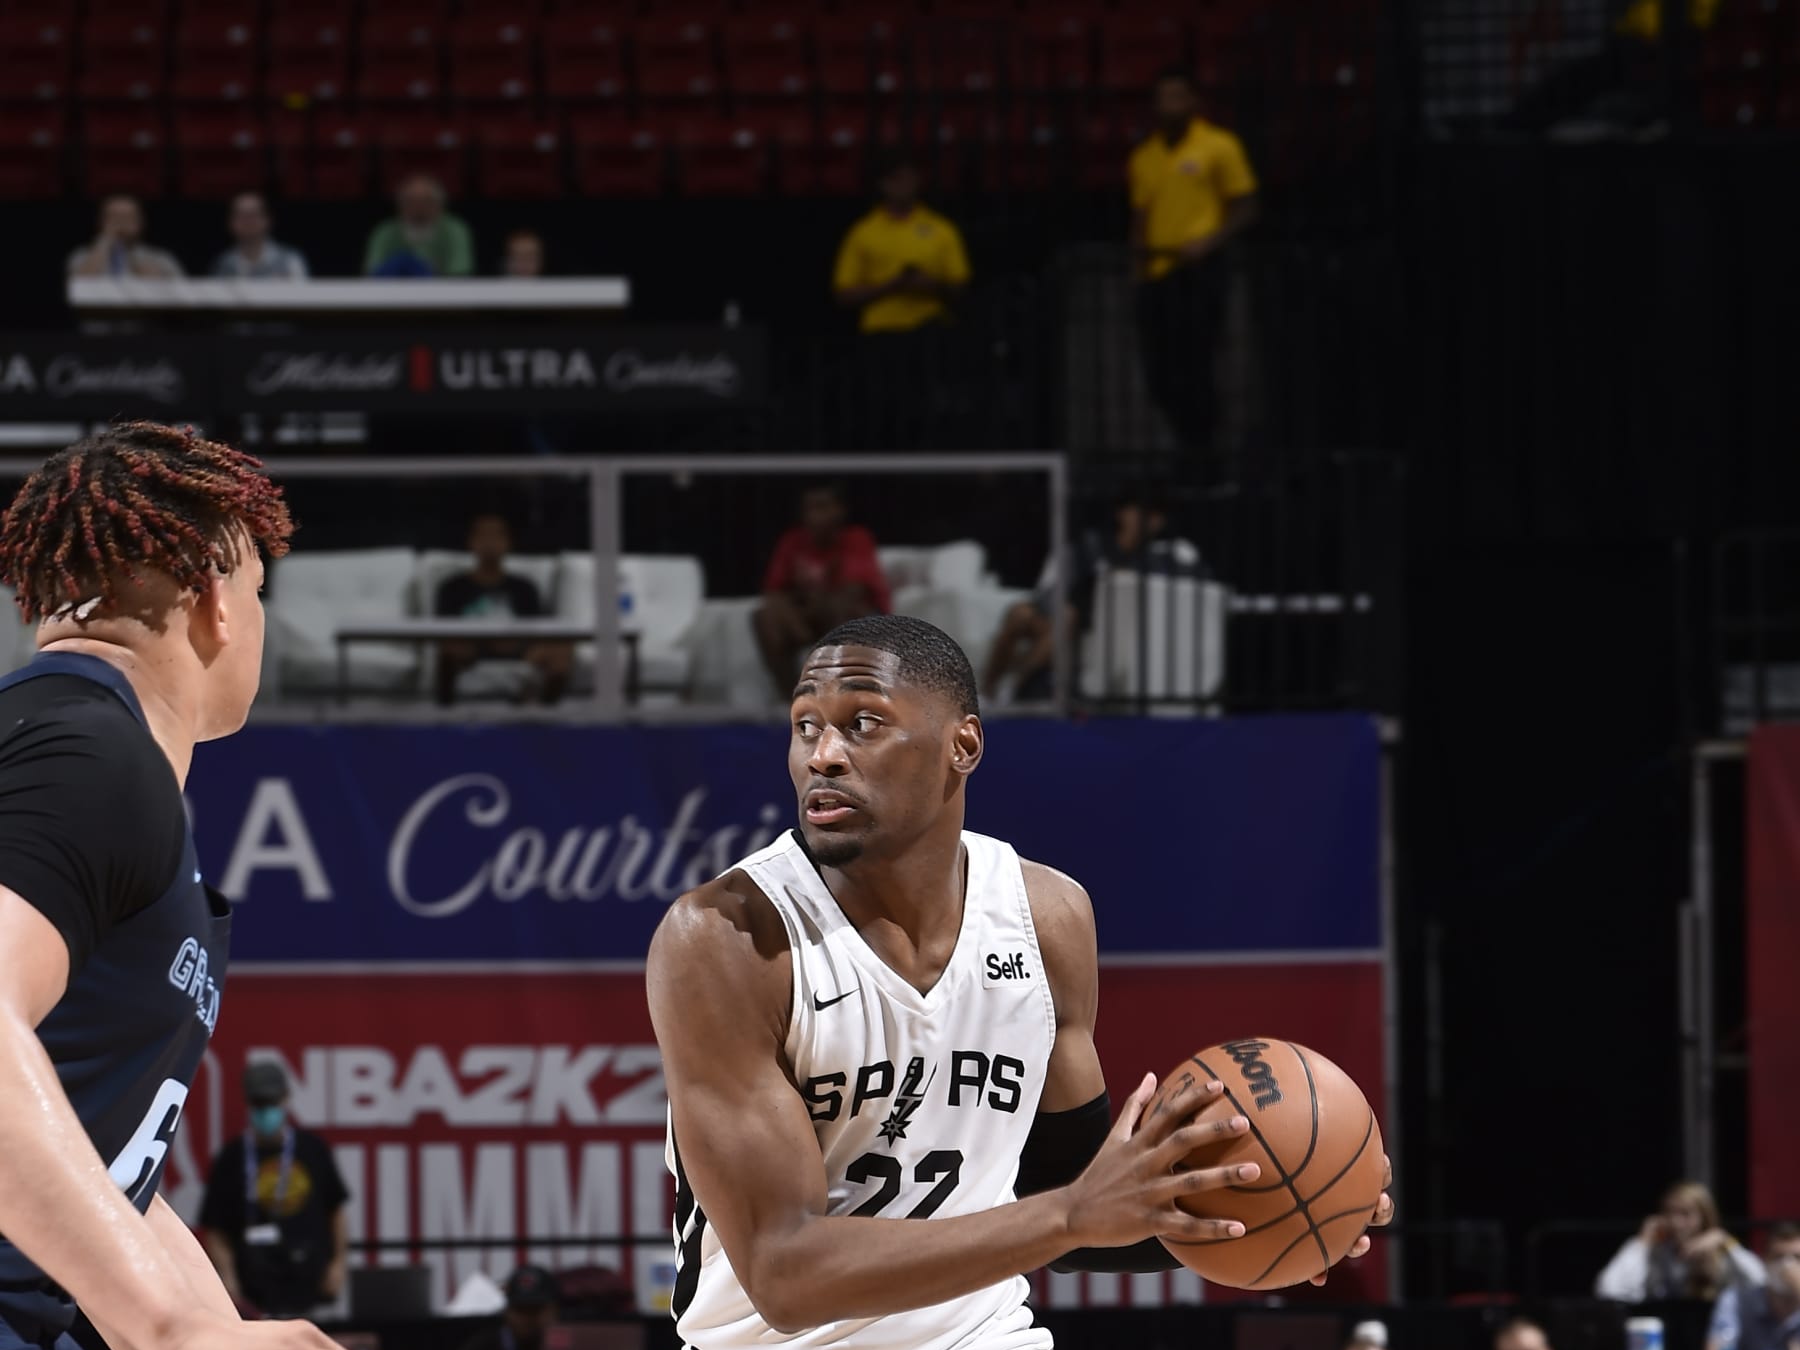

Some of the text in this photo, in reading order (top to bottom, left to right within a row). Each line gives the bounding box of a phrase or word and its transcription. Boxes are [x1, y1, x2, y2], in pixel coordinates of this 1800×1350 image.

[440, 350, 597, 389] ULTRA
[985, 951, 1031, 980] Self.
[803, 1050, 1025, 1130] SPURS
[845, 1150, 965, 1220] 22
